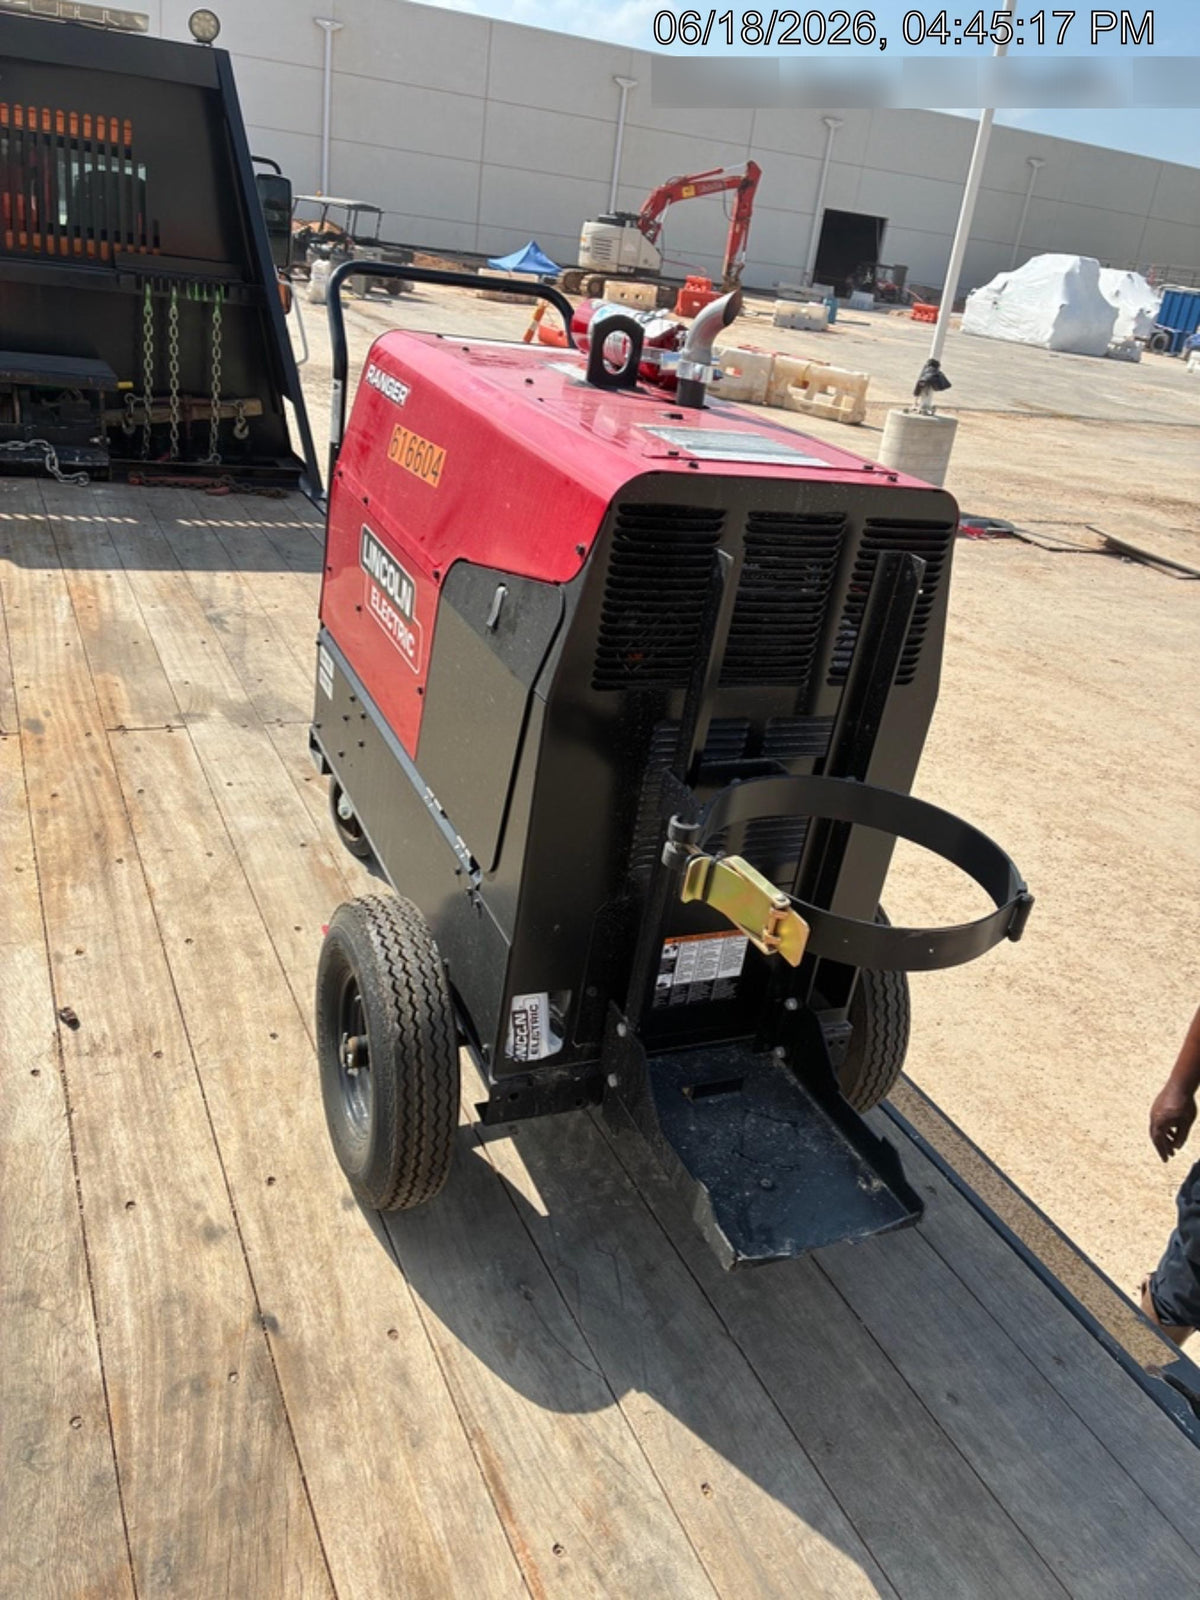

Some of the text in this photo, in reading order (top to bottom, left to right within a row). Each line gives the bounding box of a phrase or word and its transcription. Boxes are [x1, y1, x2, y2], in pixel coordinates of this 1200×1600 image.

[365, 363, 412, 409] RANGER
[389, 426, 444, 483] 616604
[362, 534, 413, 618] LINCOLN
[370, 585, 416, 658] ELECTRIC
